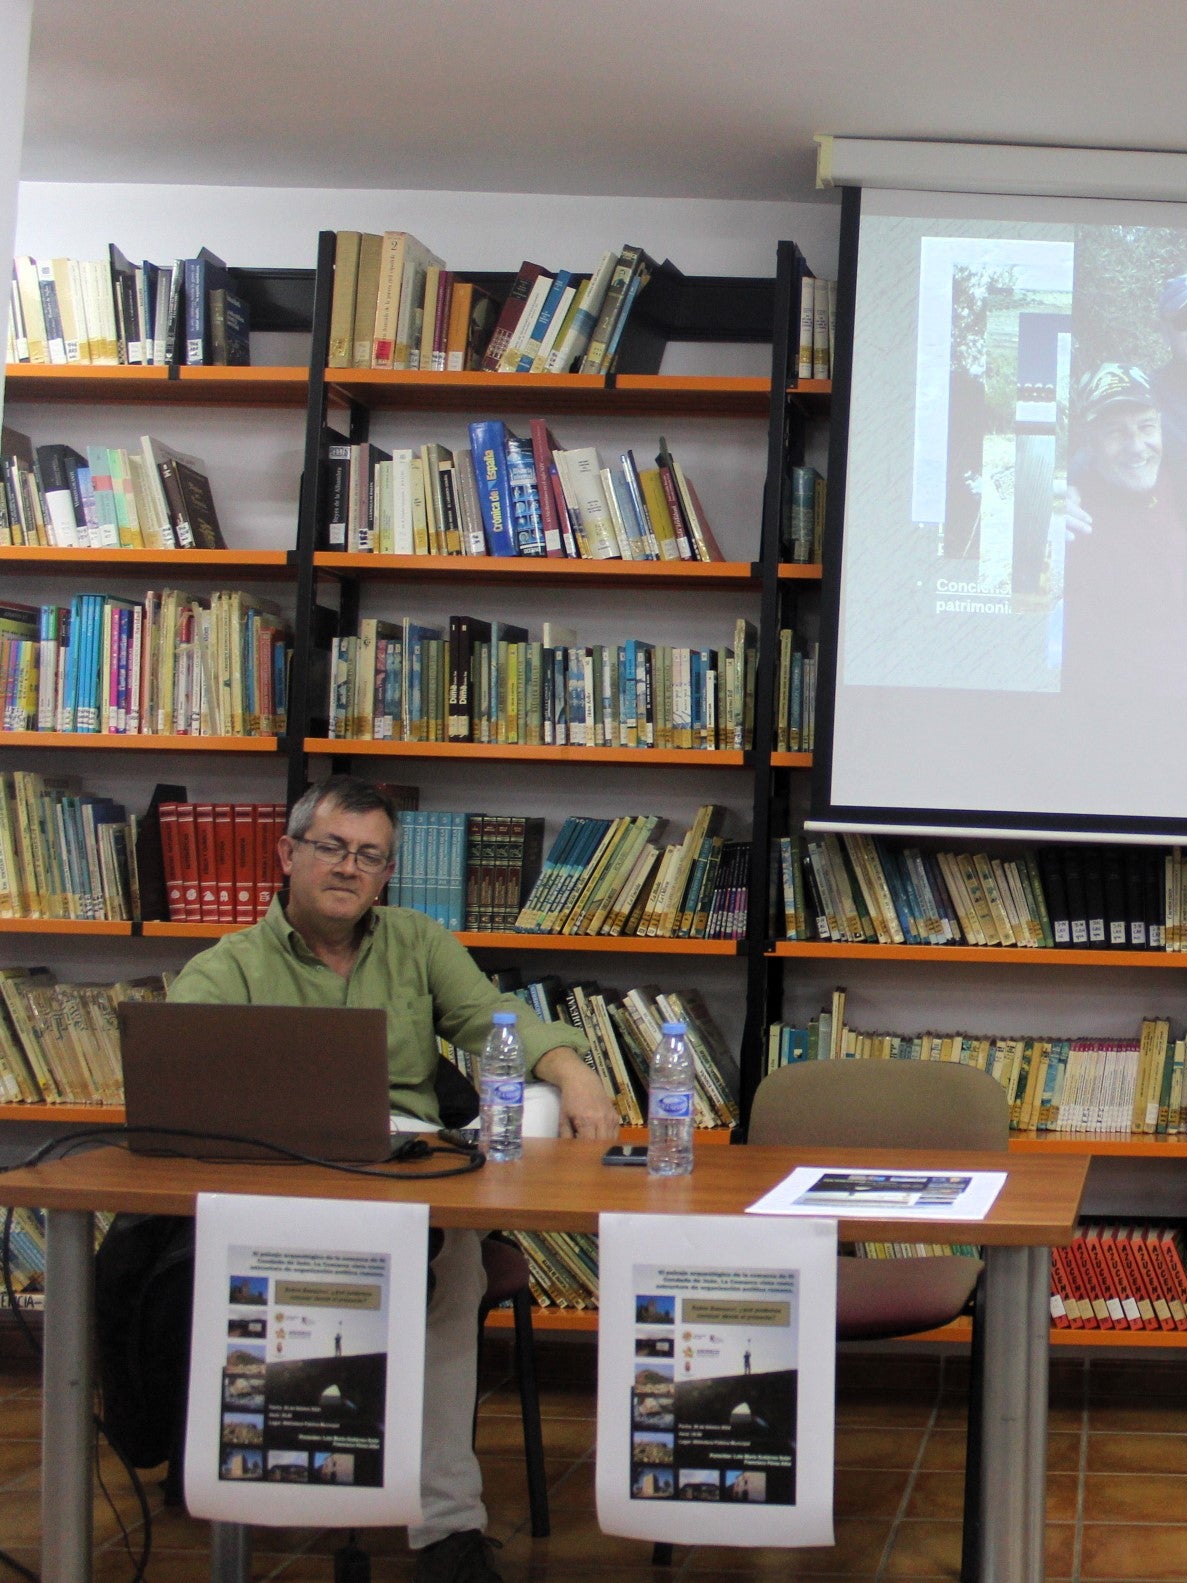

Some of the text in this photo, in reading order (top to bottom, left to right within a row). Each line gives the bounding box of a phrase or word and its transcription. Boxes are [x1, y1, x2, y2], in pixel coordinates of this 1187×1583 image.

[334, 467, 343, 493] Alhambra
[483, 449, 504, 533] Crónica de España
[332, 507, 340, 523] Reyes
[936, 599, 1012, 614] patrimoni
[1077, 1244, 1099, 1300] AZUCENA
[1091, 1244, 1114, 1300] AZUCENA
[1107, 1244, 1130, 1300] AZUCENA
[1122, 1244, 1144, 1300] AZUCENA
[1137, 1245, 1161, 1300] AZUCENA
[1152, 1245, 1176, 1301] AZUCENA
